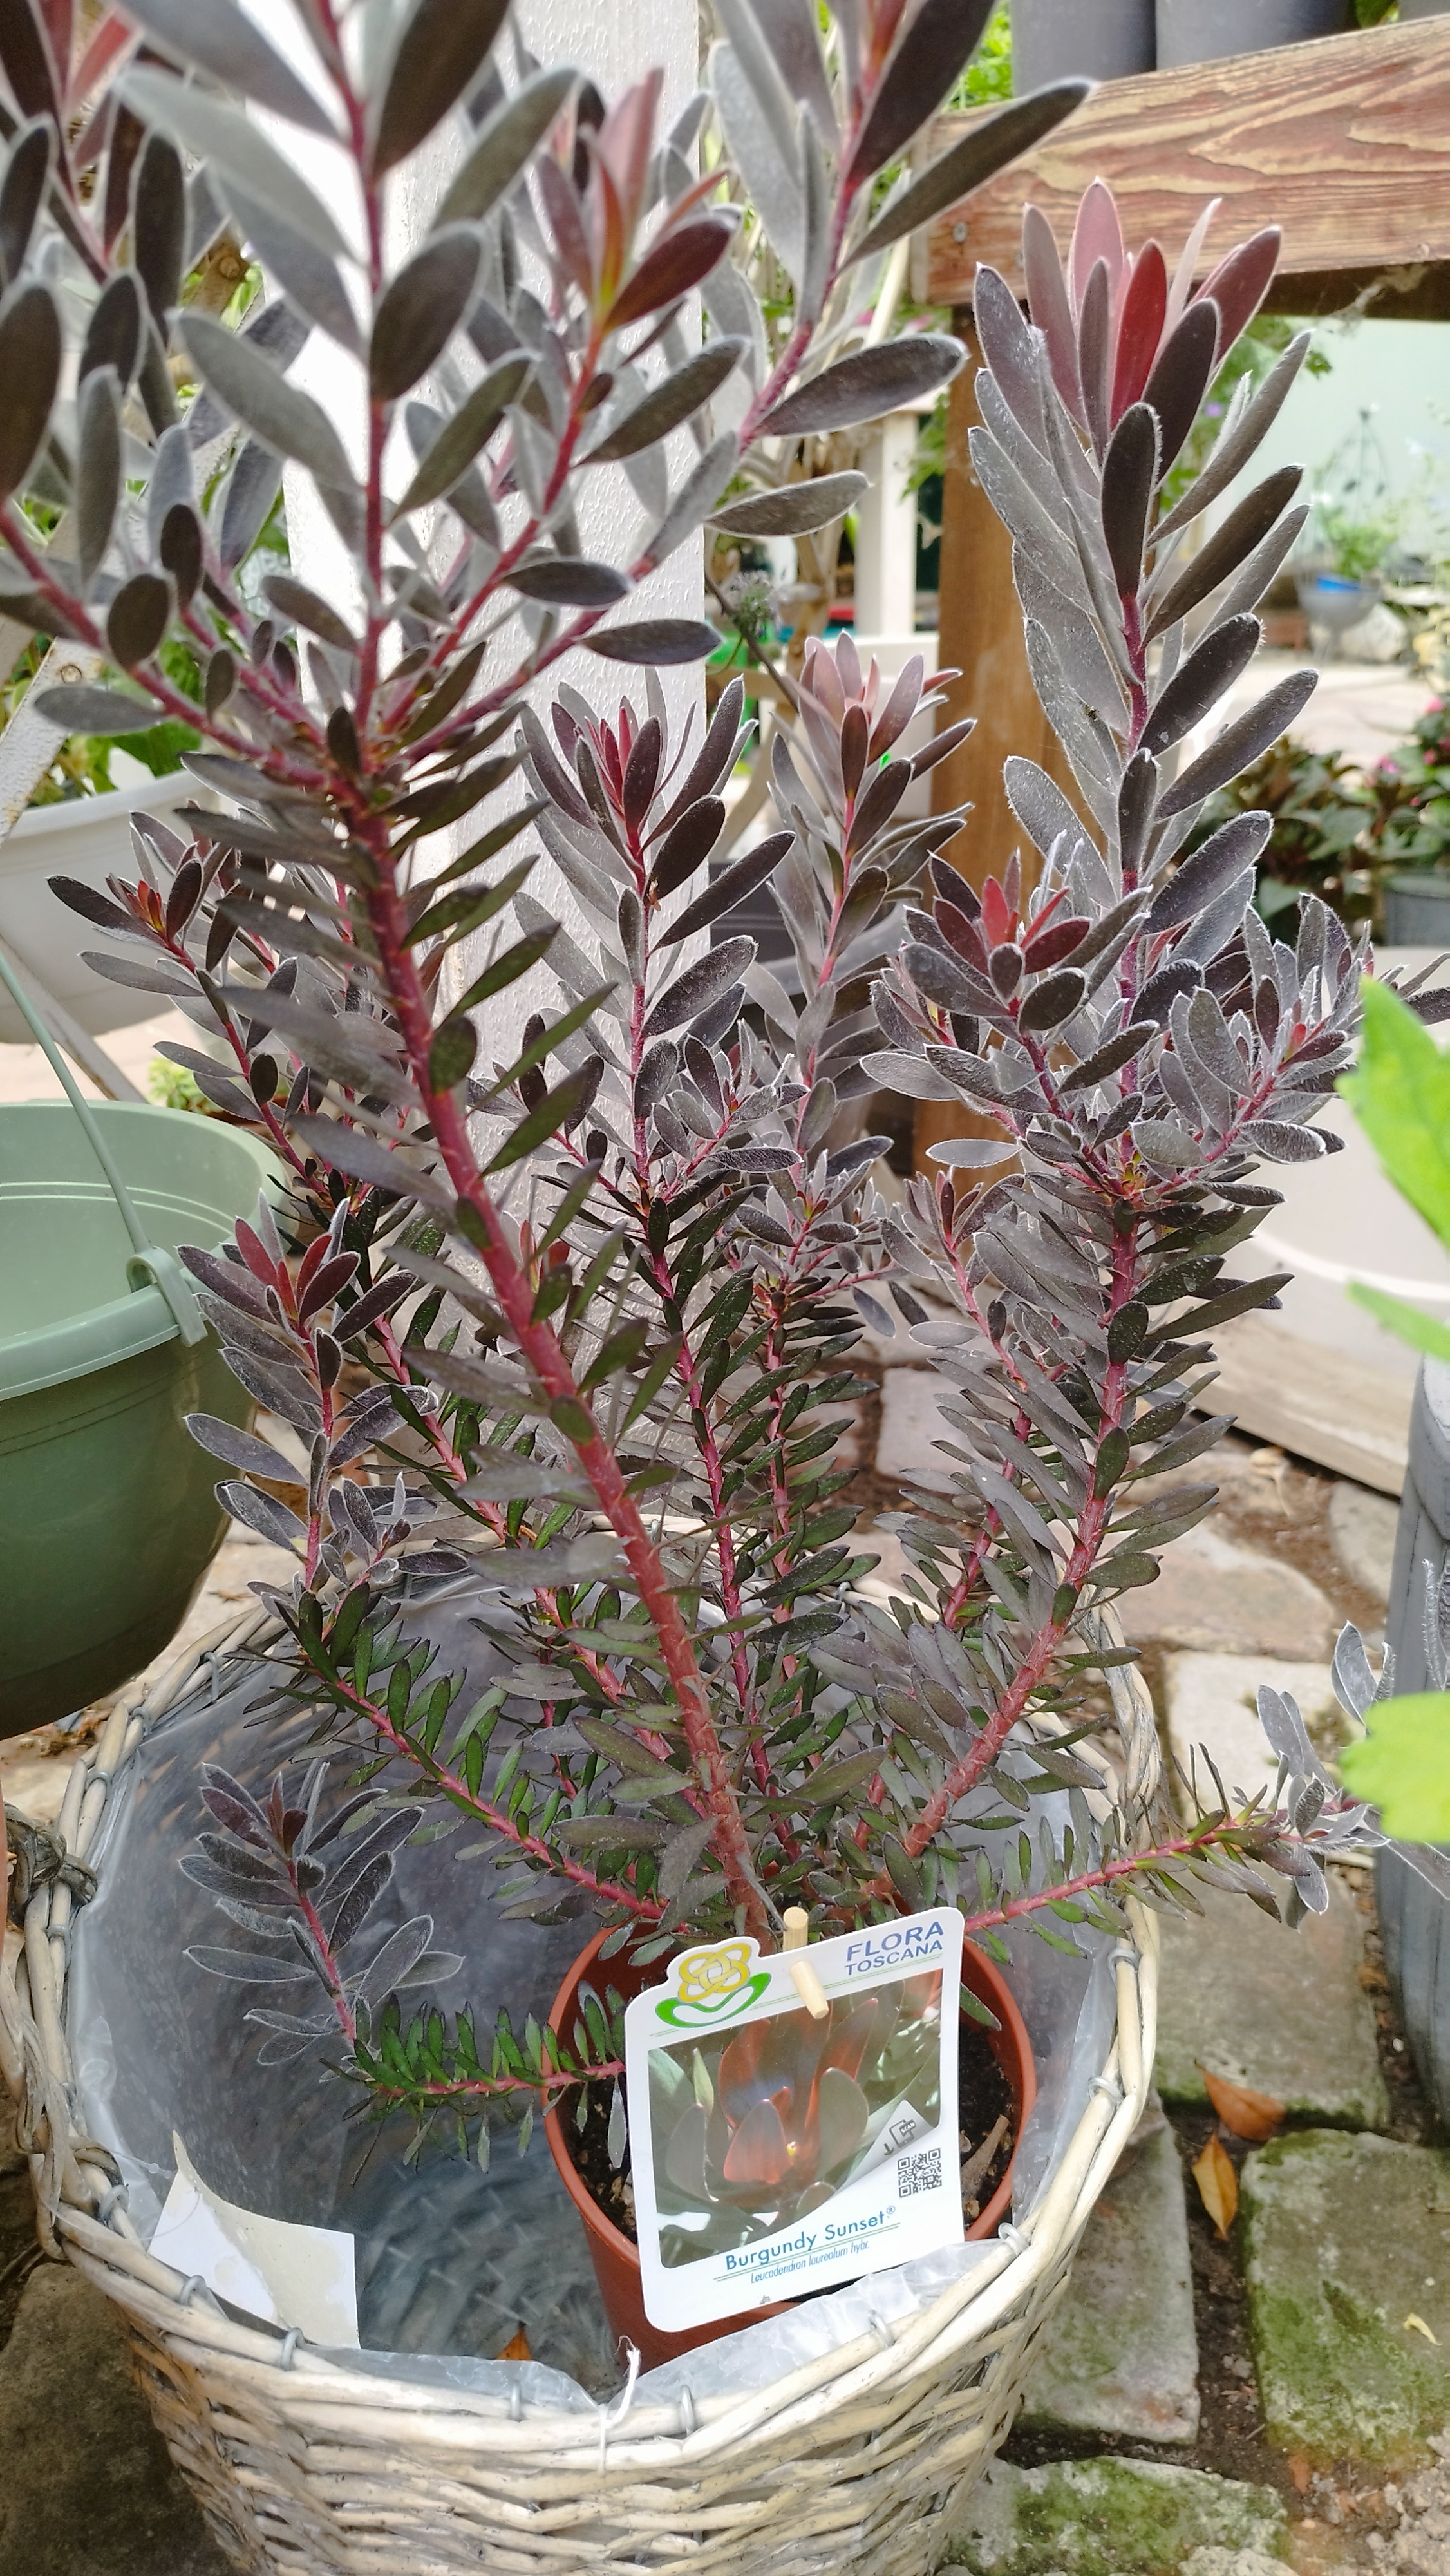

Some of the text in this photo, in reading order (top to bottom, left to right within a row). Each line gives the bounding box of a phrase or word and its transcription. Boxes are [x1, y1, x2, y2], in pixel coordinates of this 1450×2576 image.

[844, 1940, 943, 1976] TOSCANA
[847, 1921, 944, 1962] FLORA
[726, 2231, 817, 2271] Burgundy
[809, 2246, 848, 2266] laureolum
[851, 2239, 870, 2253] hybr.
